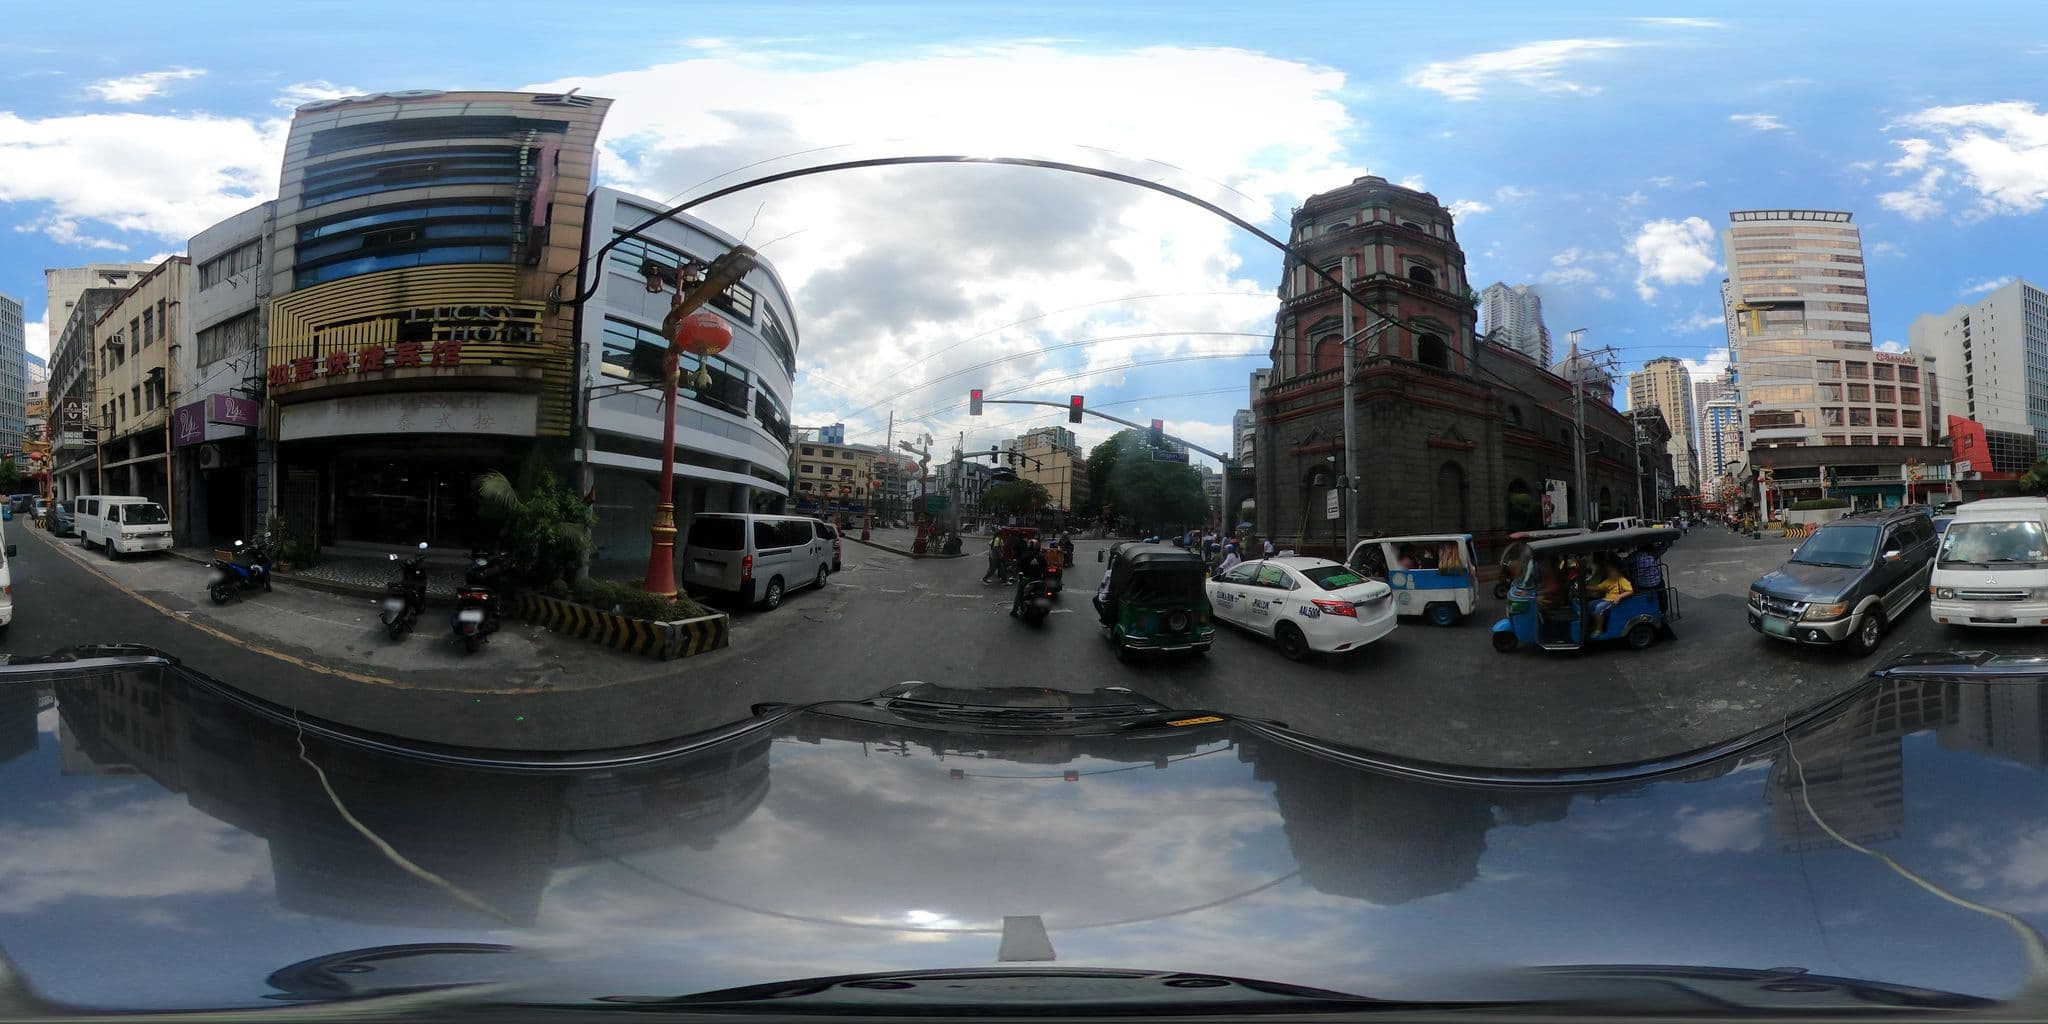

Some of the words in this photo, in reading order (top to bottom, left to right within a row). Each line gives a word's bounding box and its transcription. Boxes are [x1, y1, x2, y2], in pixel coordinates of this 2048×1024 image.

[268, 340, 462, 387] 如意快捷宾馆
